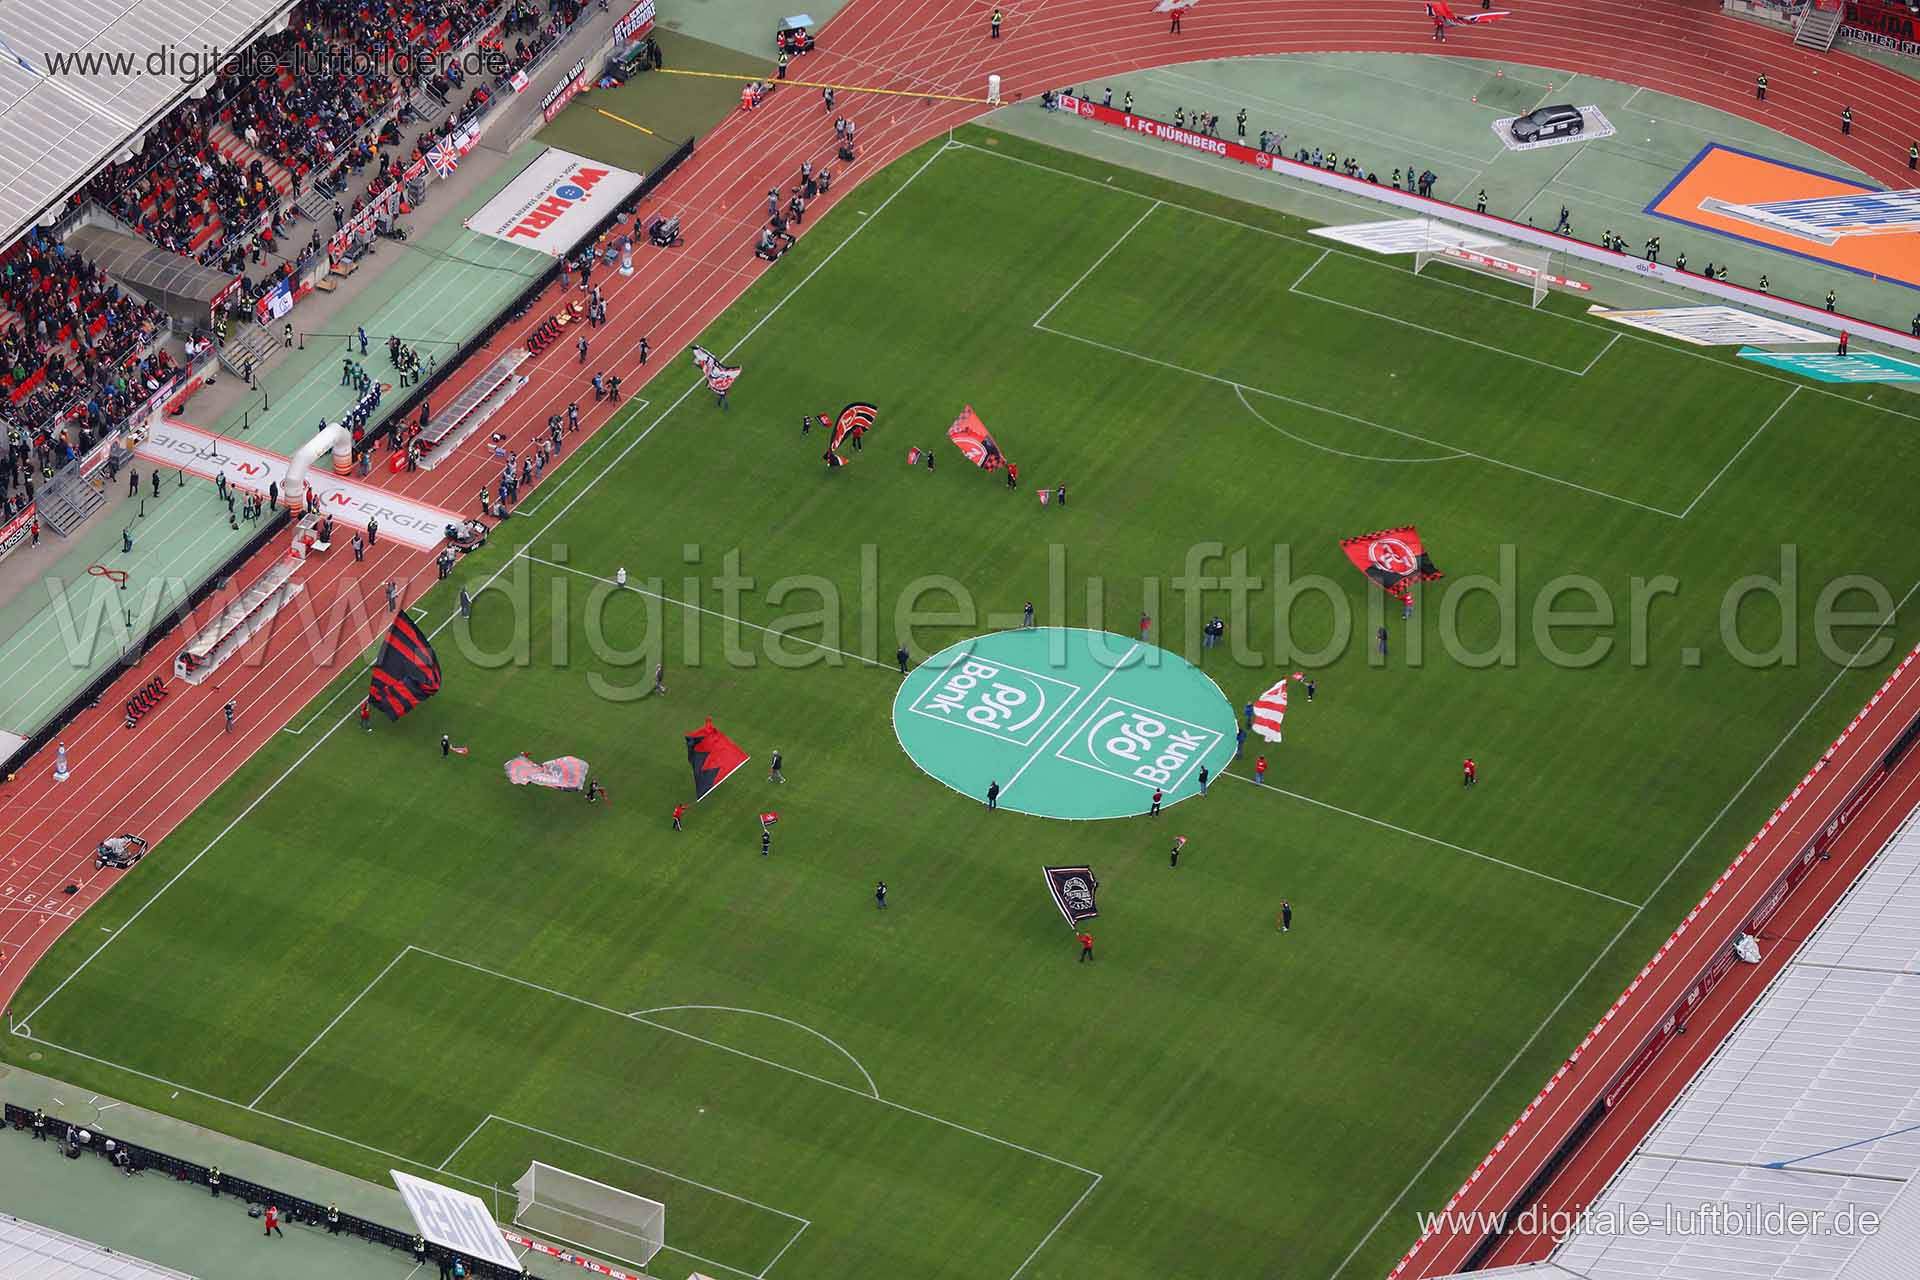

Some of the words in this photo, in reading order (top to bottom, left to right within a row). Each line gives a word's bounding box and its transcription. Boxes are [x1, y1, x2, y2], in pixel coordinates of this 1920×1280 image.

[1124, 116, 1136, 130] 1.
[1138, 119, 1154, 135] FC
[1156, 121, 1227, 155] NÜRNBERG
[329, 492, 440, 535] N-ERGIE
[925, 660, 998, 714] Bank
[1133, 729, 1208, 784] Bank
